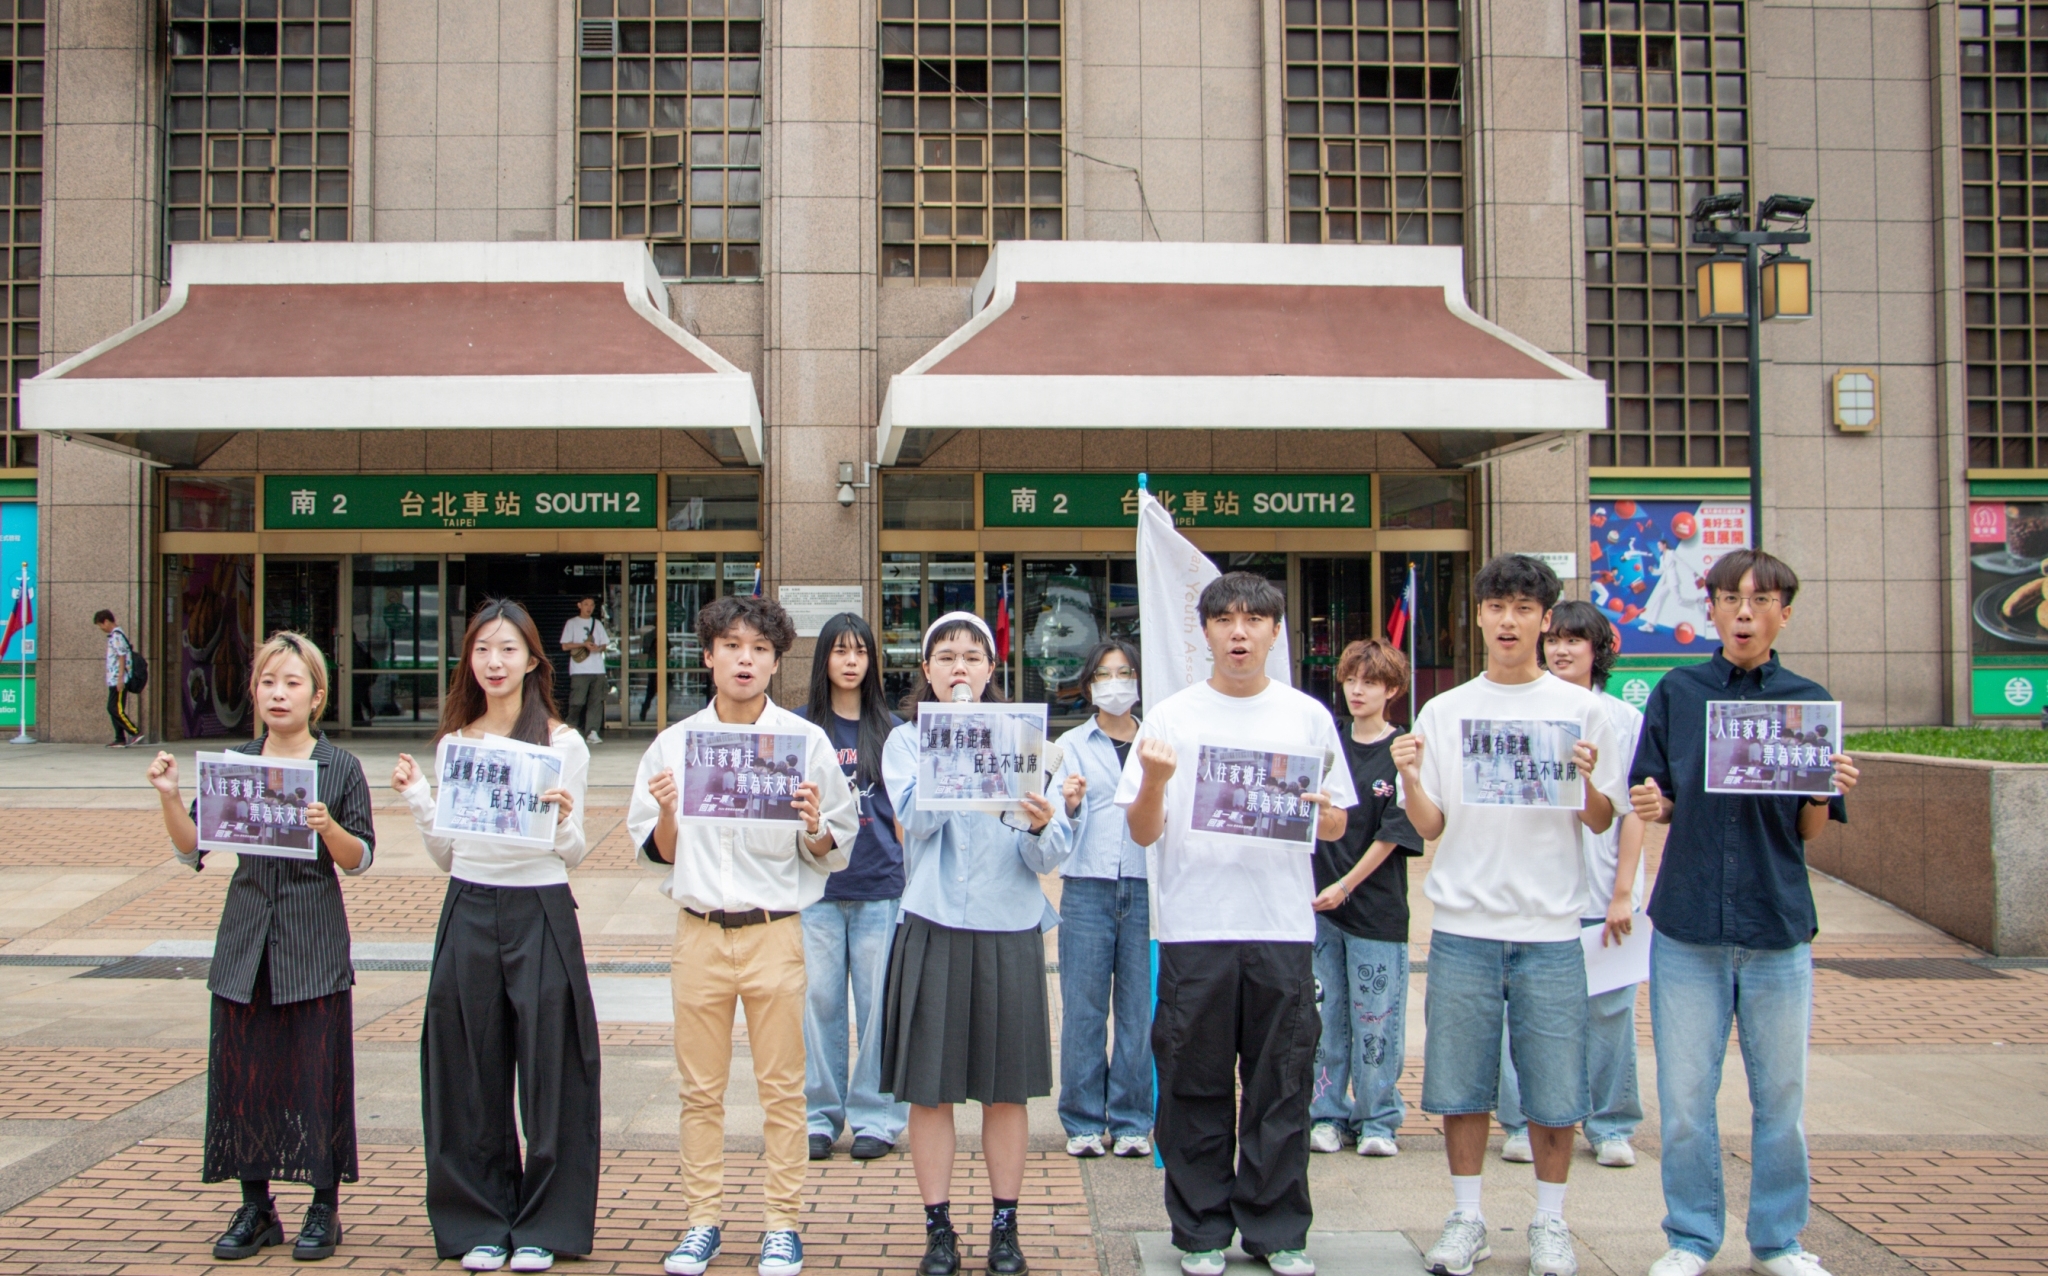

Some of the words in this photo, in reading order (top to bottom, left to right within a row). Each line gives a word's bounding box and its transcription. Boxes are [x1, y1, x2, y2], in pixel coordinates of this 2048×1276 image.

[291, 489, 317, 515] 南
[333, 494, 347, 514] 2
[400, 491, 521, 517] 台北車站
[535, 493, 619, 513] SOUTH
[625, 493, 641, 513] 2
[1011, 487, 1037, 513] 南
[1053, 494, 1068, 513] 2
[1253, 493, 1336, 513] SOUTH
[1340, 493, 1355, 513] 2
[443, 518, 476, 527] TAIPEI
[1175, 518, 1195, 526] IPEI
[1703, 518, 1743, 528] 美好生活
[1184, 580, 1200, 634] Youth
[2, 689, 16, 703] 站
[927, 728, 992, 749] 返鄉有距離
[1469, 734, 1530, 756] 返鄉有距離
[974, 753, 1037, 774] 民主不缺席
[1763, 745, 1831, 767] 票為未來投
[450, 760, 511, 786] 返鄉有距離
[1514, 760, 1577, 782] 民主不缺席
[1246, 791, 1311, 818] 票為未來投
